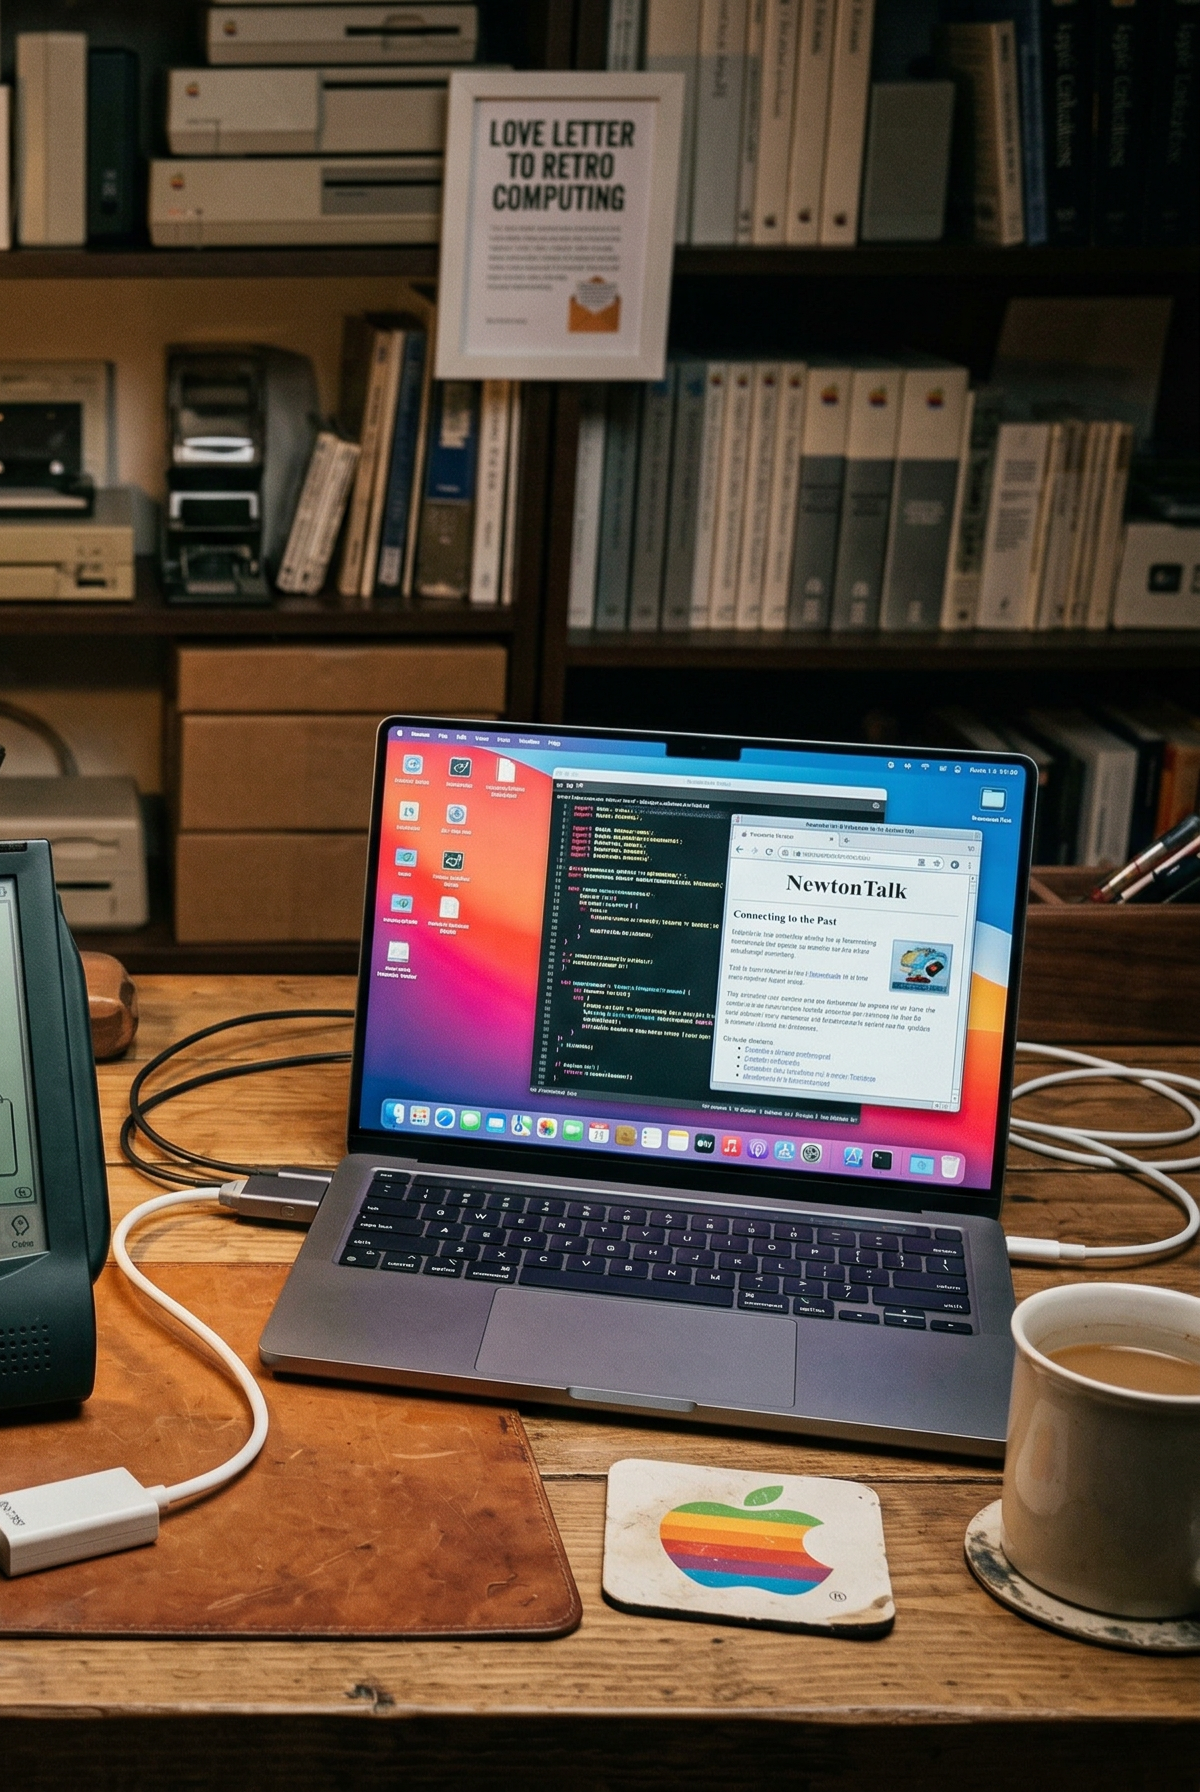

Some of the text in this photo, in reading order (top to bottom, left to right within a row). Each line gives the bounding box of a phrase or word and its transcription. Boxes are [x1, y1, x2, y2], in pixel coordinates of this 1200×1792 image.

[489, 119, 635, 148] LOVE LETTER
[508, 152, 614, 179] TO RETRO
[492, 184, 626, 211] COMPUTING
[733, 909, 785, 924] Connecting
[800, 915, 815, 925] the
[817, 916, 837, 926] Past
